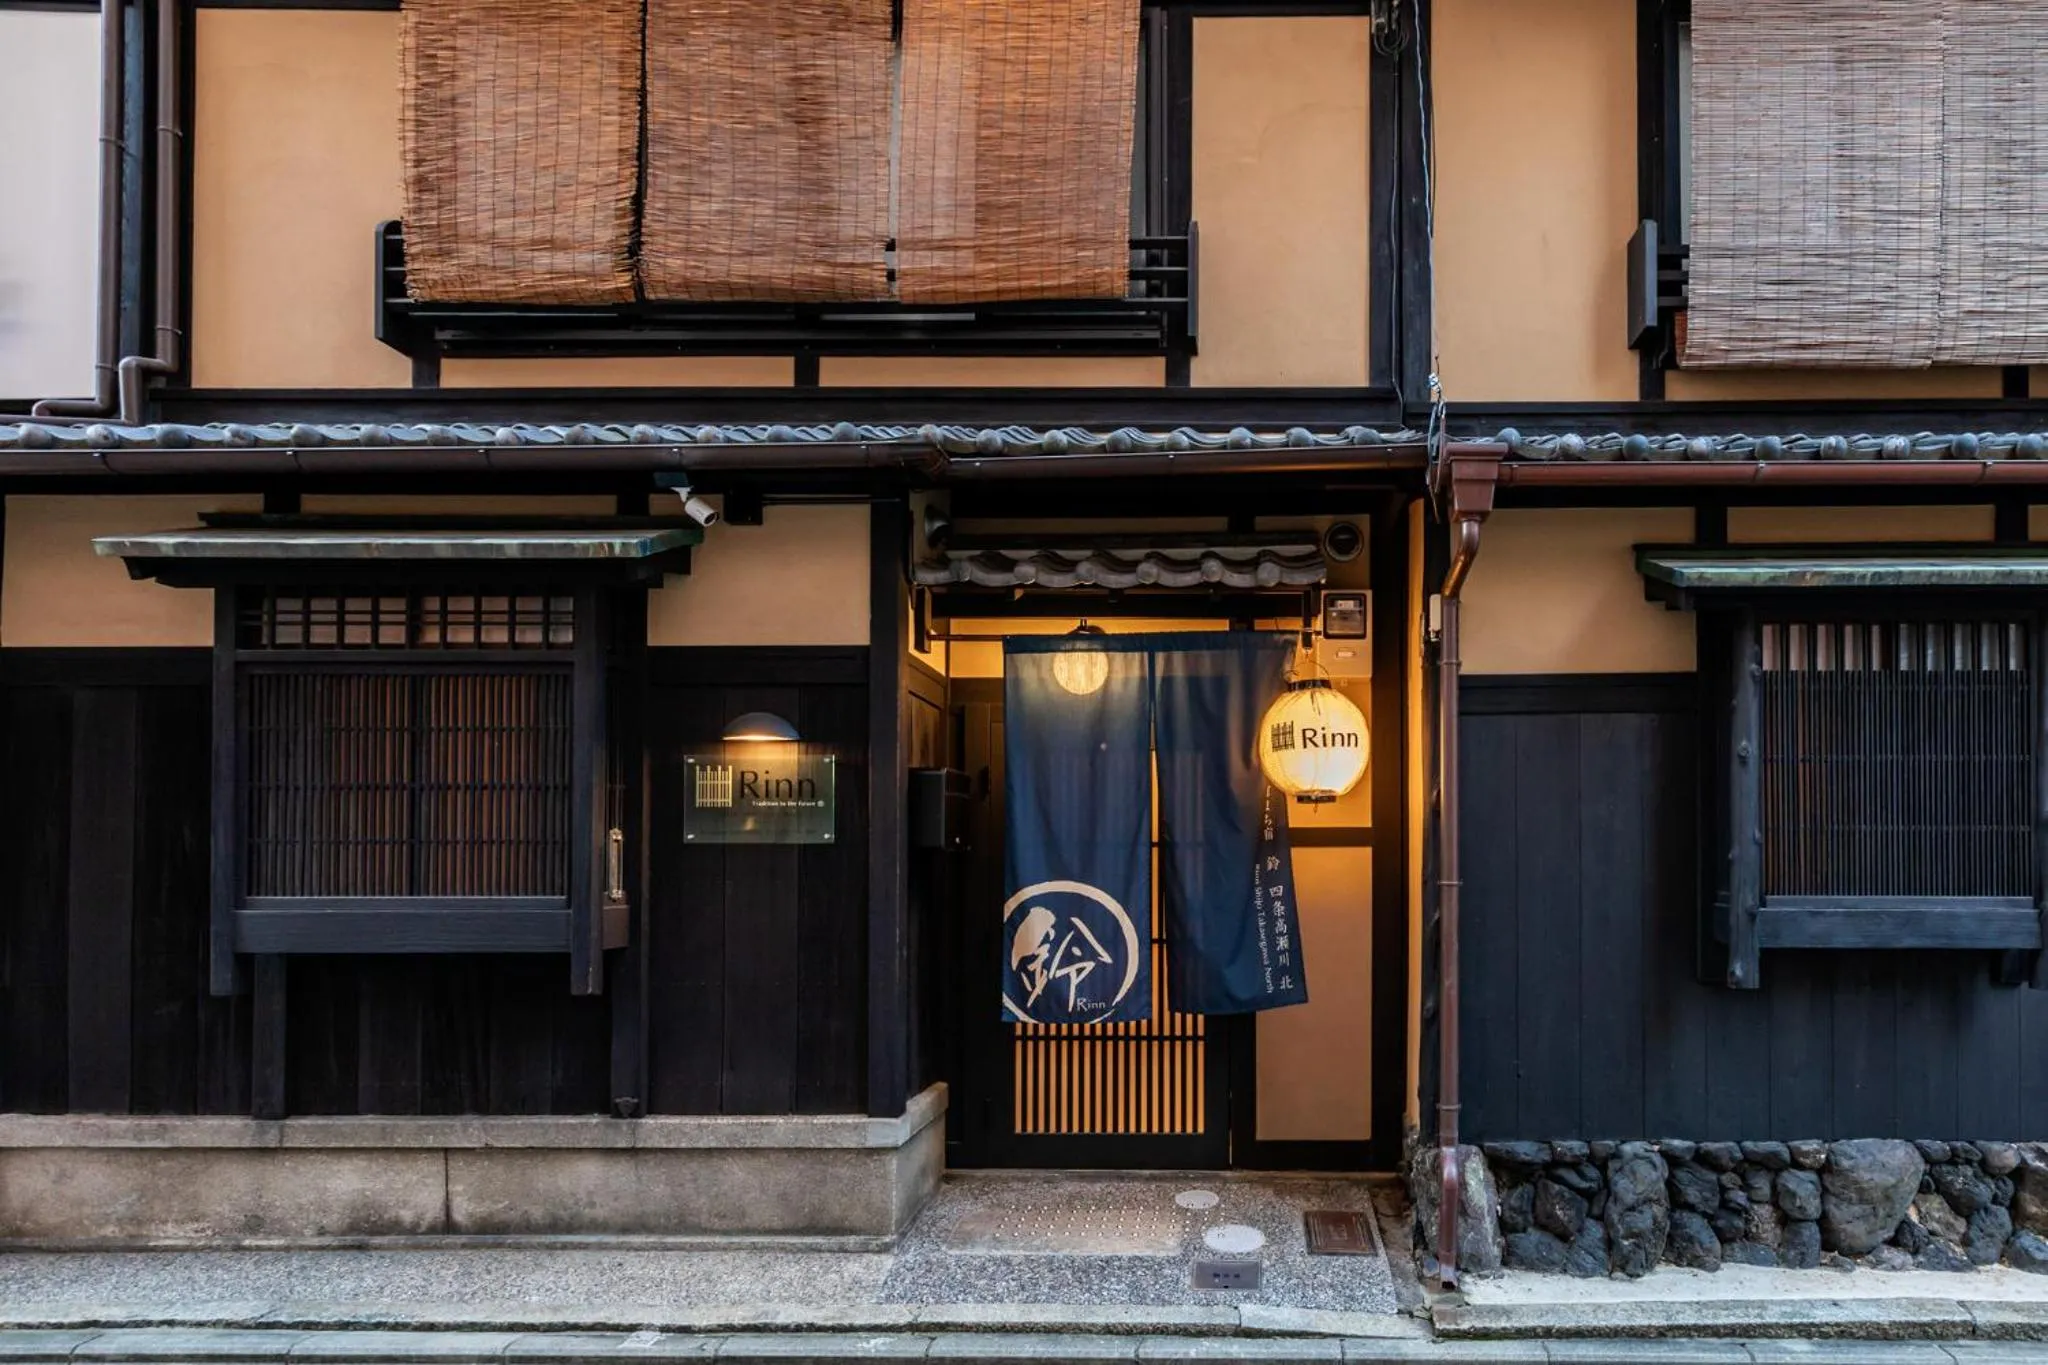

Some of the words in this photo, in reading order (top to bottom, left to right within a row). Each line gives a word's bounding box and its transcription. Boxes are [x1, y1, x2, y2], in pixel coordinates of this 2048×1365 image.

[1301, 727, 1358, 749] Rinn
[739, 770, 816, 799] Rinn
[1279, 975, 1294, 990] 北
[1076, 997, 1106, 1011] Rinn
